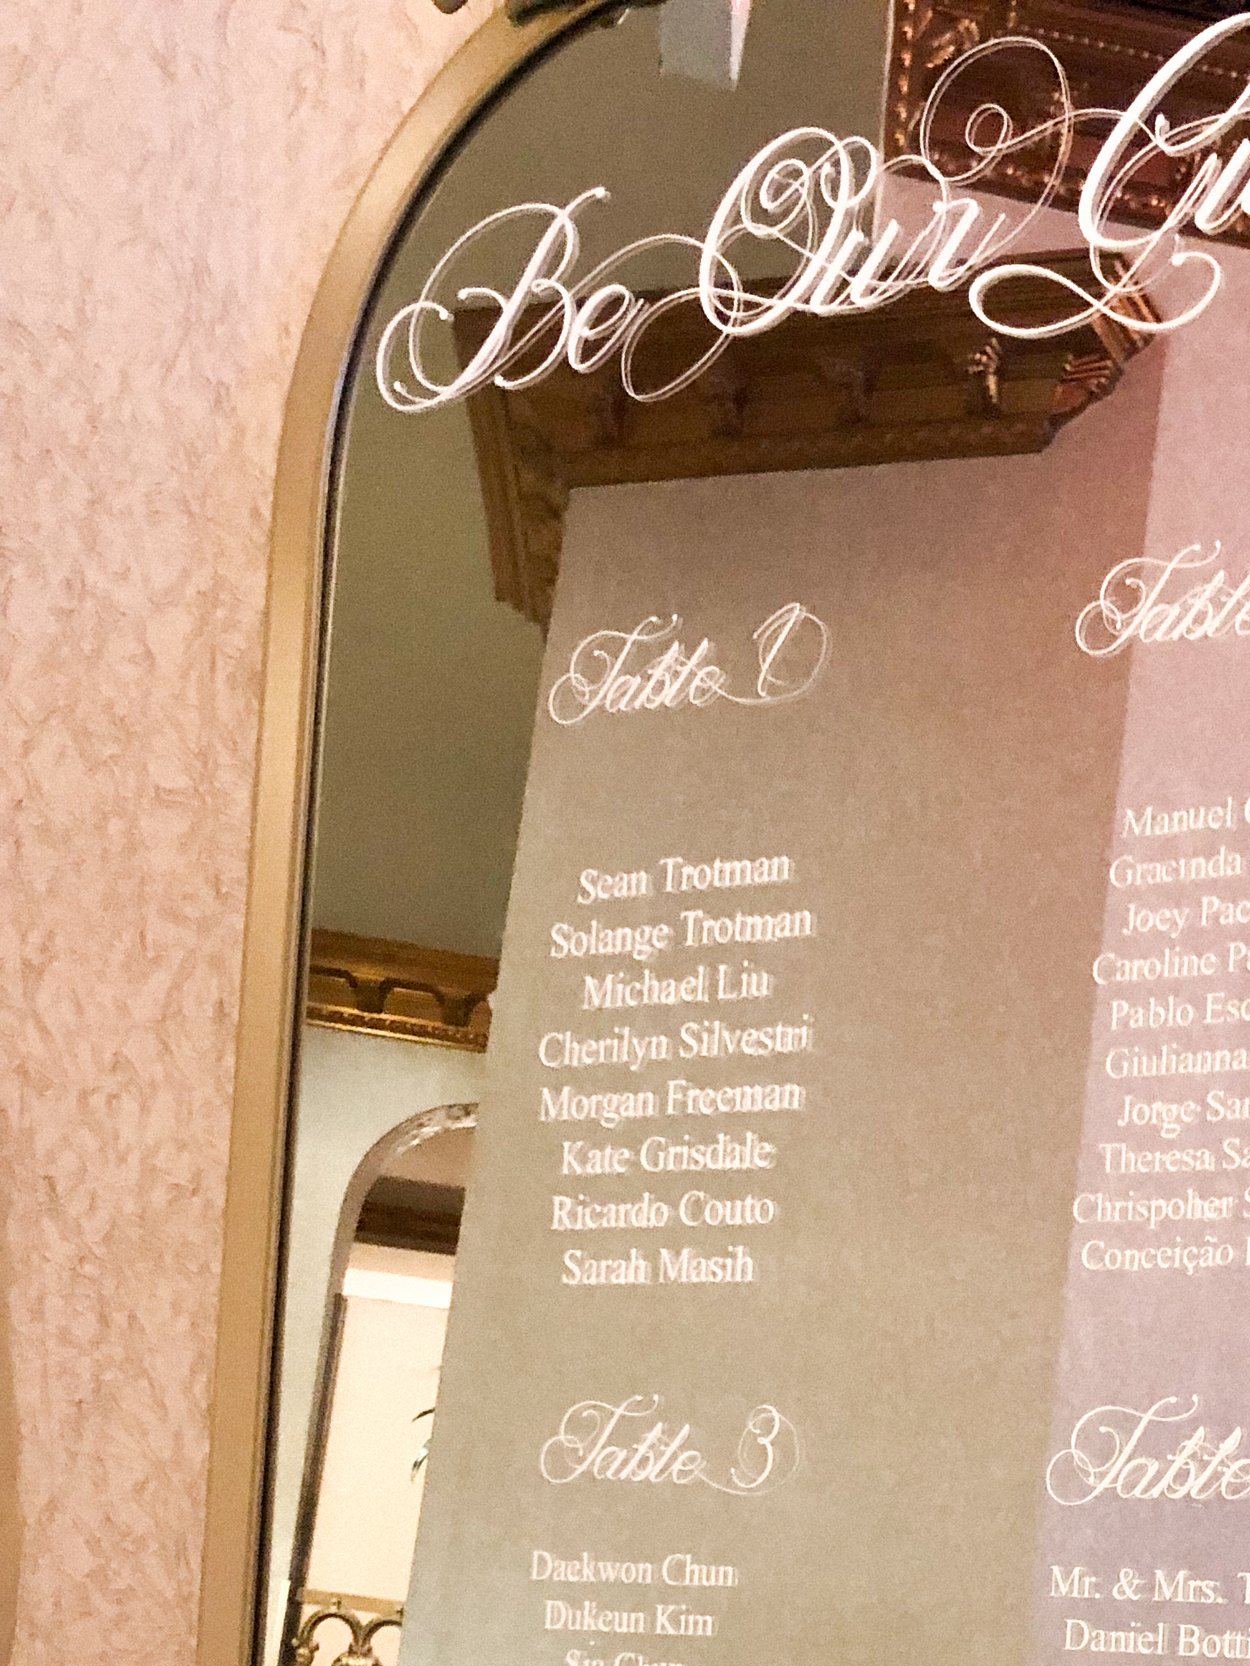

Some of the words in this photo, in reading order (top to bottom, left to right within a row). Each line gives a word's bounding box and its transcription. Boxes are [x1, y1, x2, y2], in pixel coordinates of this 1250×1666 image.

[376, 184, 680, 416] Be
[700, 100, 1040, 338] Our
[548, 614, 740, 725] Table
[1122, 797, 1237, 839] Manuel
[577, 868, 652, 905] Sean
[659, 854, 793, 894] Trotman
[1109, 845, 1243, 889] Gracinda
[549, 921, 673, 961] Solange
[680, 907, 816, 949] Trotman
[1122, 900, 1189, 939] Joey
[582, 966, 709, 1010] Michael
[717, 959, 774, 1001] Liu
[1092, 946, 1218, 985] Caroline
[1109, 995, 1194, 1031] Pablo
[538, 1027, 668, 1071] Cherilyn
[679, 1014, 815, 1059] Silvestri
[1105, 1041, 1249, 1080] Giulianna
[538, 1085, 658, 1128] Morgan
[666, 1079, 807, 1116] Freeman
[1117, 1095, 1200, 1138] Jorge
[561, 1140, 630, 1176] Kate
[640, 1131, 777, 1173] Grisdale
[1099, 1140, 1215, 1175] Theresa
[551, 1191, 670, 1230] Ricardo
[679, 1190, 778, 1227] Couto
[562, 1248, 650, 1285] Sarah
[658, 1245, 754, 1283] Masih
[1081, 1234, 1234, 1275] Conceição
[541, 1394, 712, 1484] Table
[529, 1549, 652, 1585] Daekwon
[661, 1553, 738, 1588] Chun
[1049, 1565, 1100, 1600] Mr.
[1111, 1567, 1144, 1600] &
[1153, 1568, 1225, 1605] Mrs.
[544, 1600, 645, 1634] Dukeun
[654, 1604, 716, 1637] Kim
[1063, 1619, 1167, 1656] Daniel
